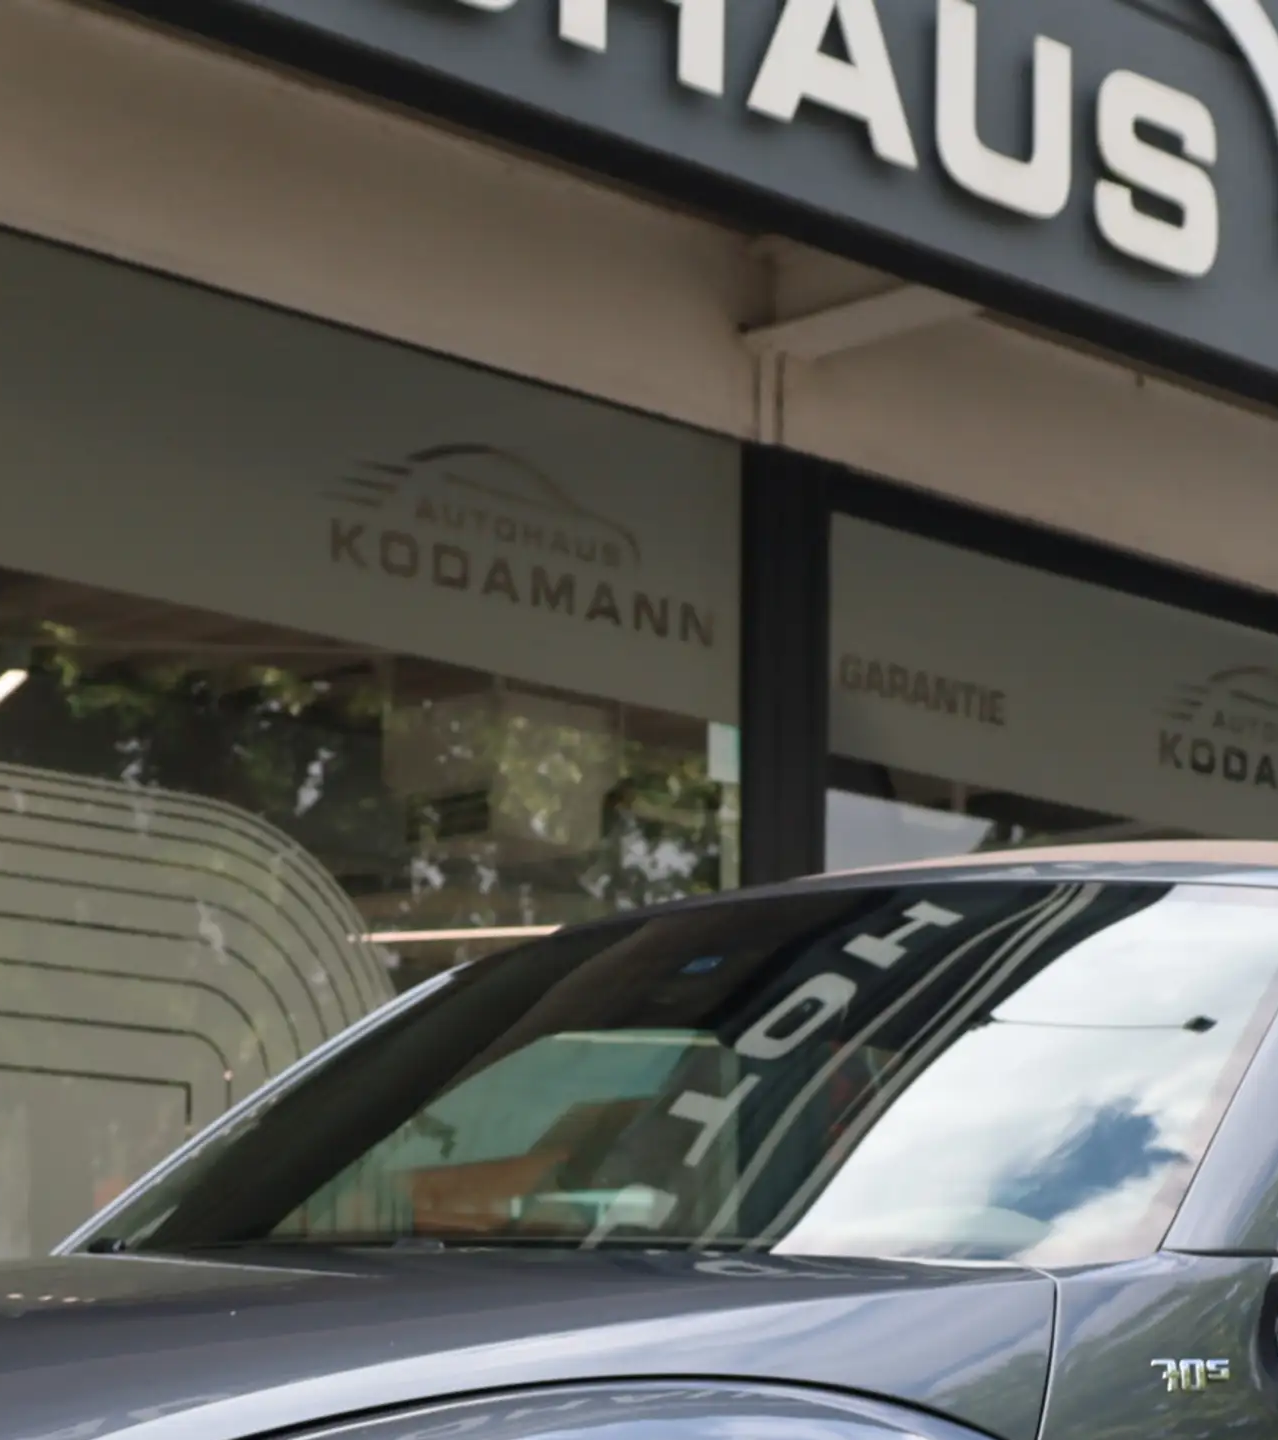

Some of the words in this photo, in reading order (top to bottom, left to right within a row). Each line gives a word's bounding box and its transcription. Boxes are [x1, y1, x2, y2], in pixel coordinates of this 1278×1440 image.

[414, 500, 624, 571] AUTOHAUS
[328, 517, 716, 648] KODAMANN
[838, 652, 1007, 727] GARANTIE
